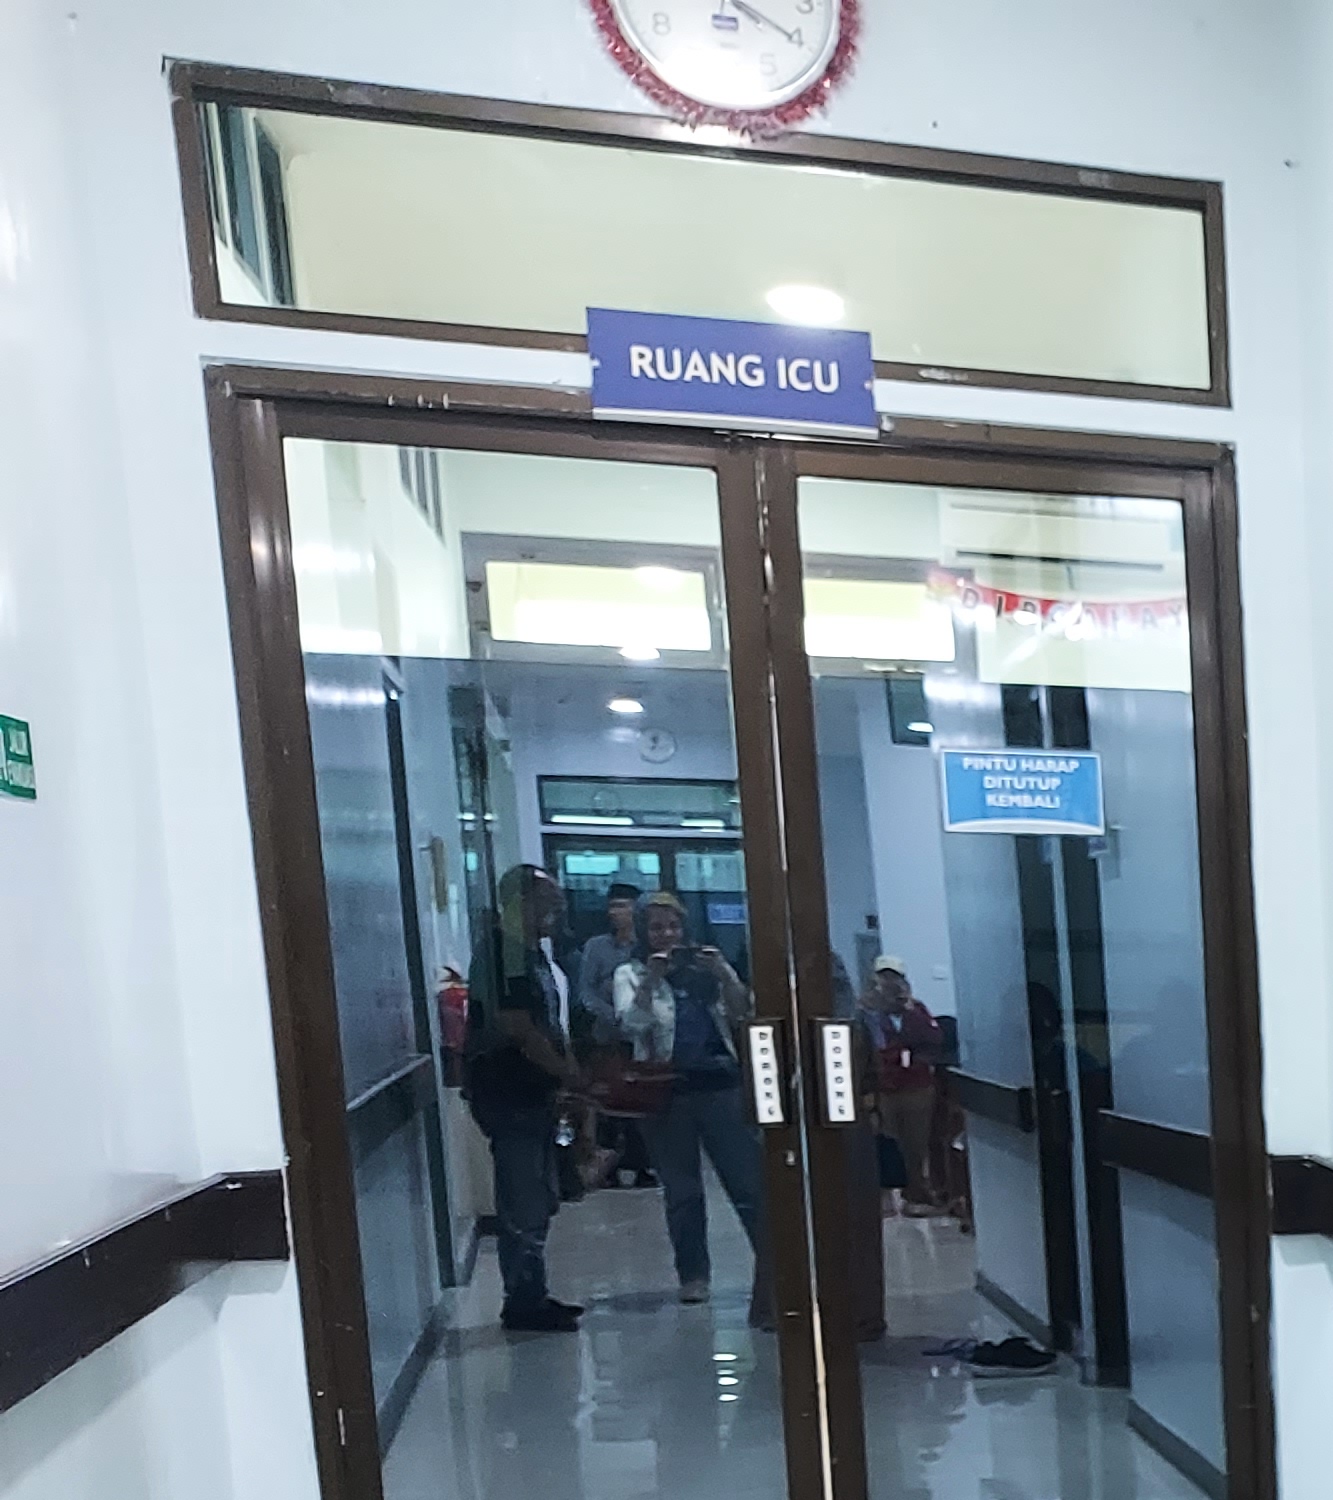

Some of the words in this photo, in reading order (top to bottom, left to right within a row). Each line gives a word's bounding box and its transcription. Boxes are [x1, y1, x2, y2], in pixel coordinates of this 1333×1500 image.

[629, 344, 766, 387] RUANG
[777, 357, 840, 393] ICU
[962, 757, 1016, 772] PINTU
[1021, 759, 1080, 773] HARAP
[983, 776, 1062, 790] DITUTUP
[985, 793, 1061, 808] KEMBALI
